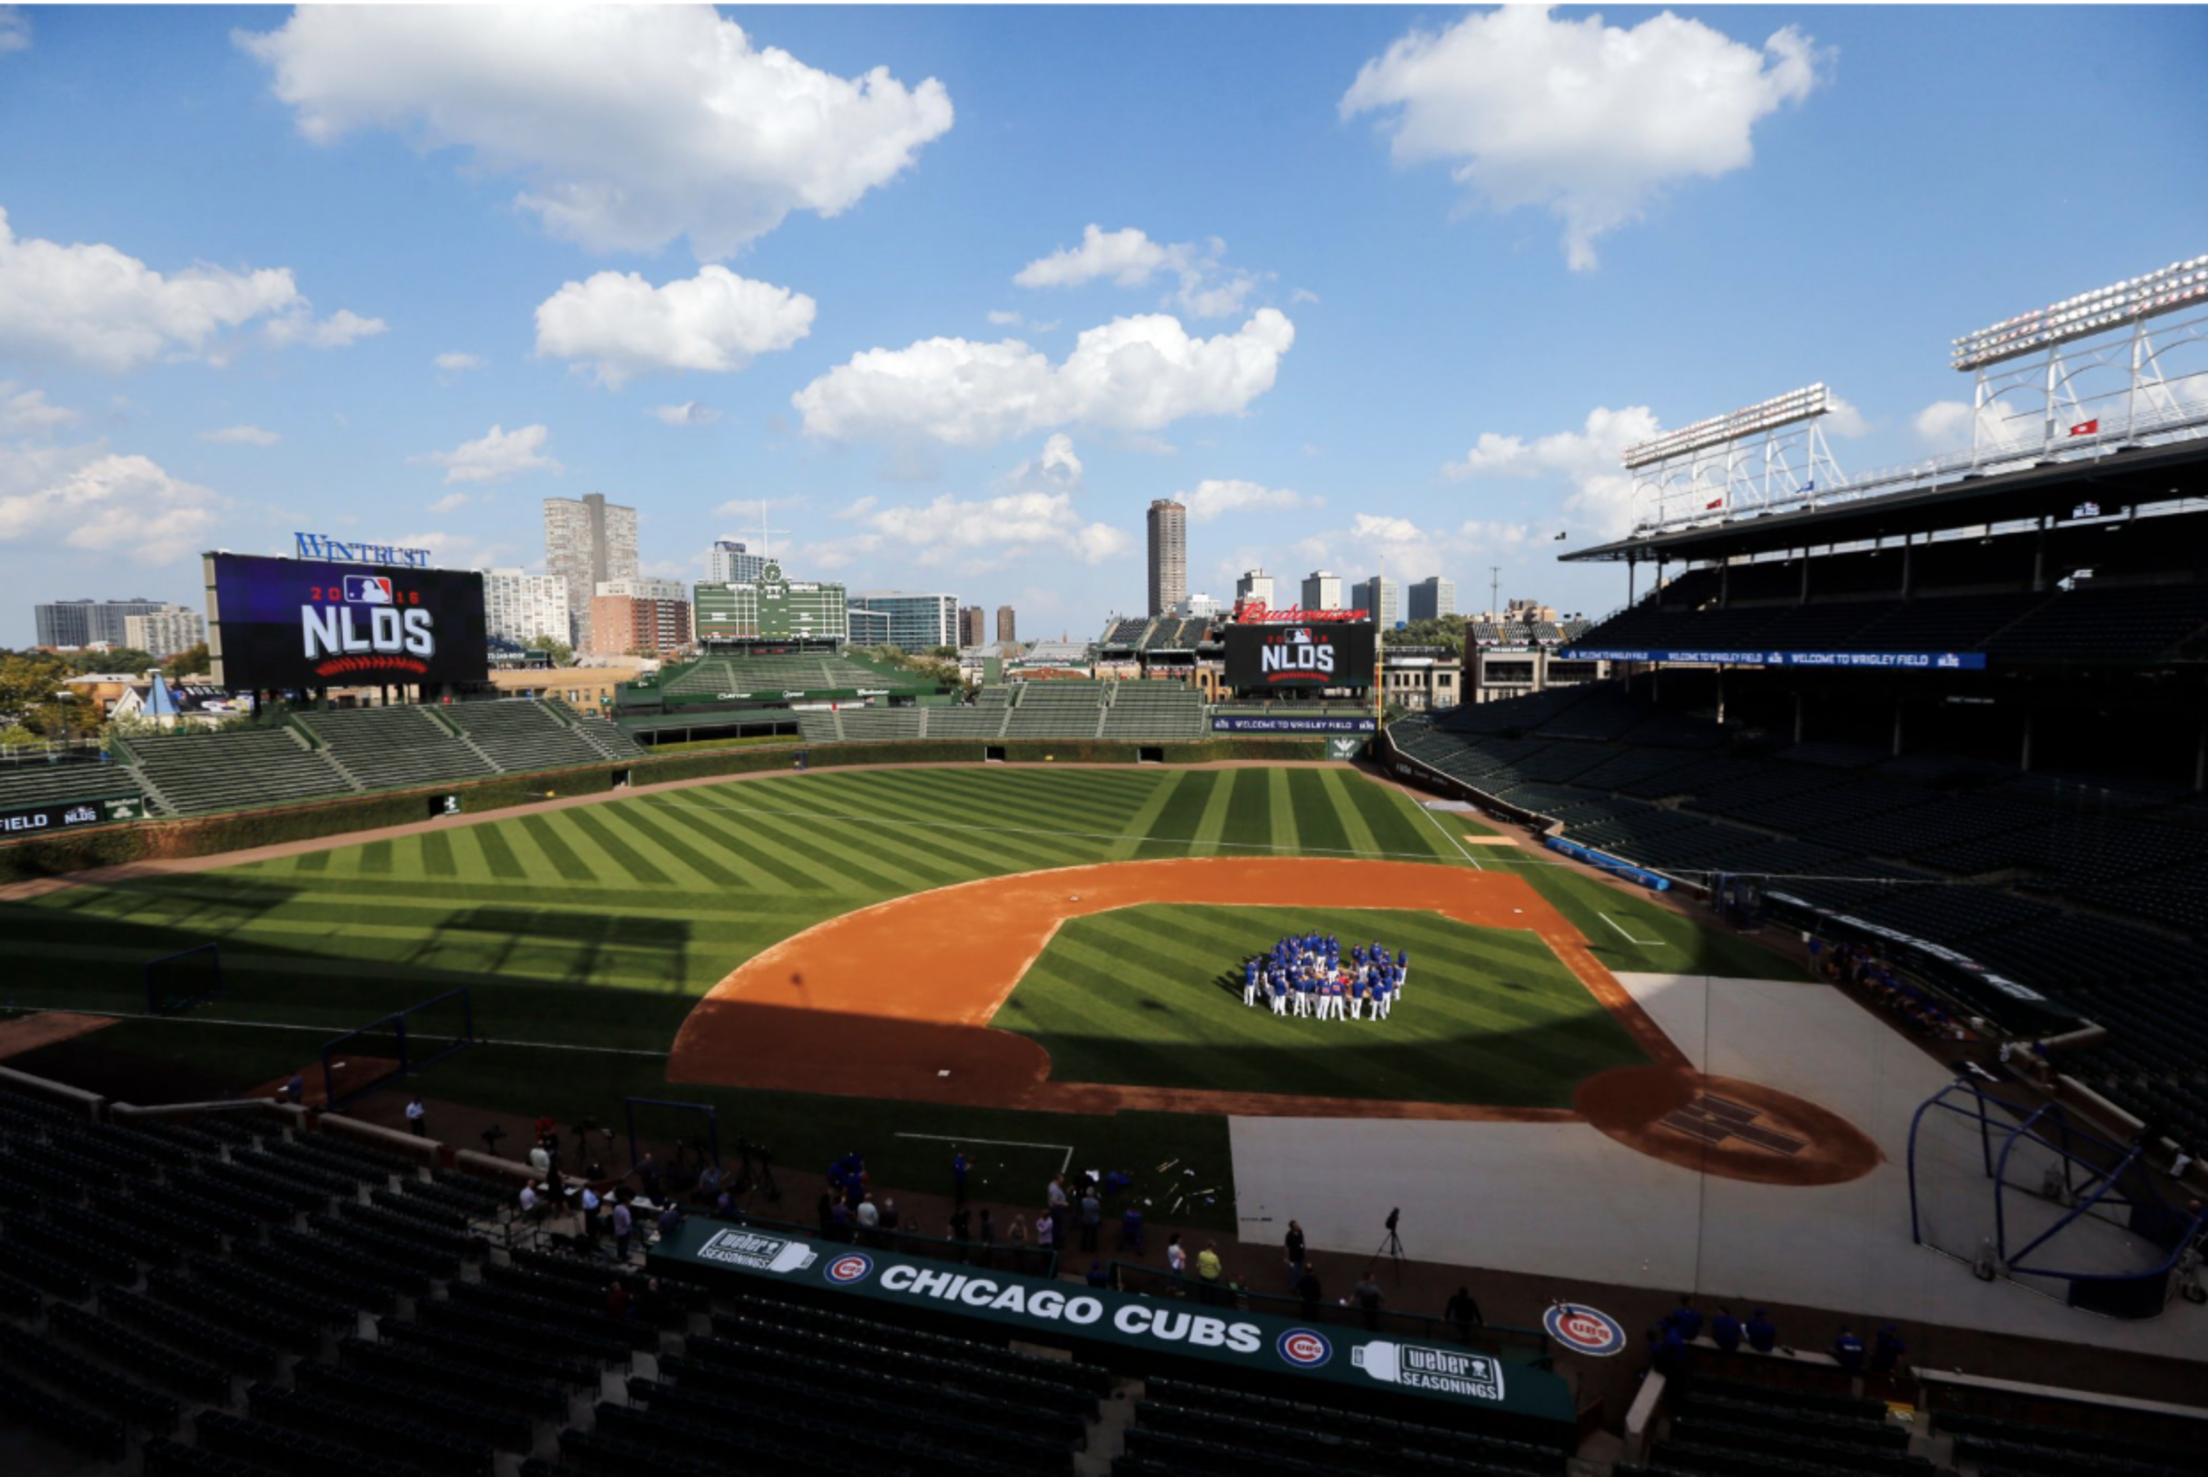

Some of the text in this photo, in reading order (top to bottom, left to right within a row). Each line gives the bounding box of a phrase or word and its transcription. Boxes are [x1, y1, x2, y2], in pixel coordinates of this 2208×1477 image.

[294, 532, 430, 567] WINTRUST
[1234, 601, 1367, 624] Budweiser
[301, 605, 434, 660] NLDS
[1262, 644, 1334, 673] NLDS
[1791, 654, 1835, 664] WELCOME
[1837, 655, 1849, 664] TO
[1851, 655, 1896, 665] WRIGLEY
[1897, 655, 1929, 666] FIELD
[64, 809, 97, 825] NLDS
[880, 1265, 1262, 1353] CHICAGO CUBS
[1409, 1349, 1469, 1375] weber
[1402, 1371, 1497, 1400] SEASONINGS
